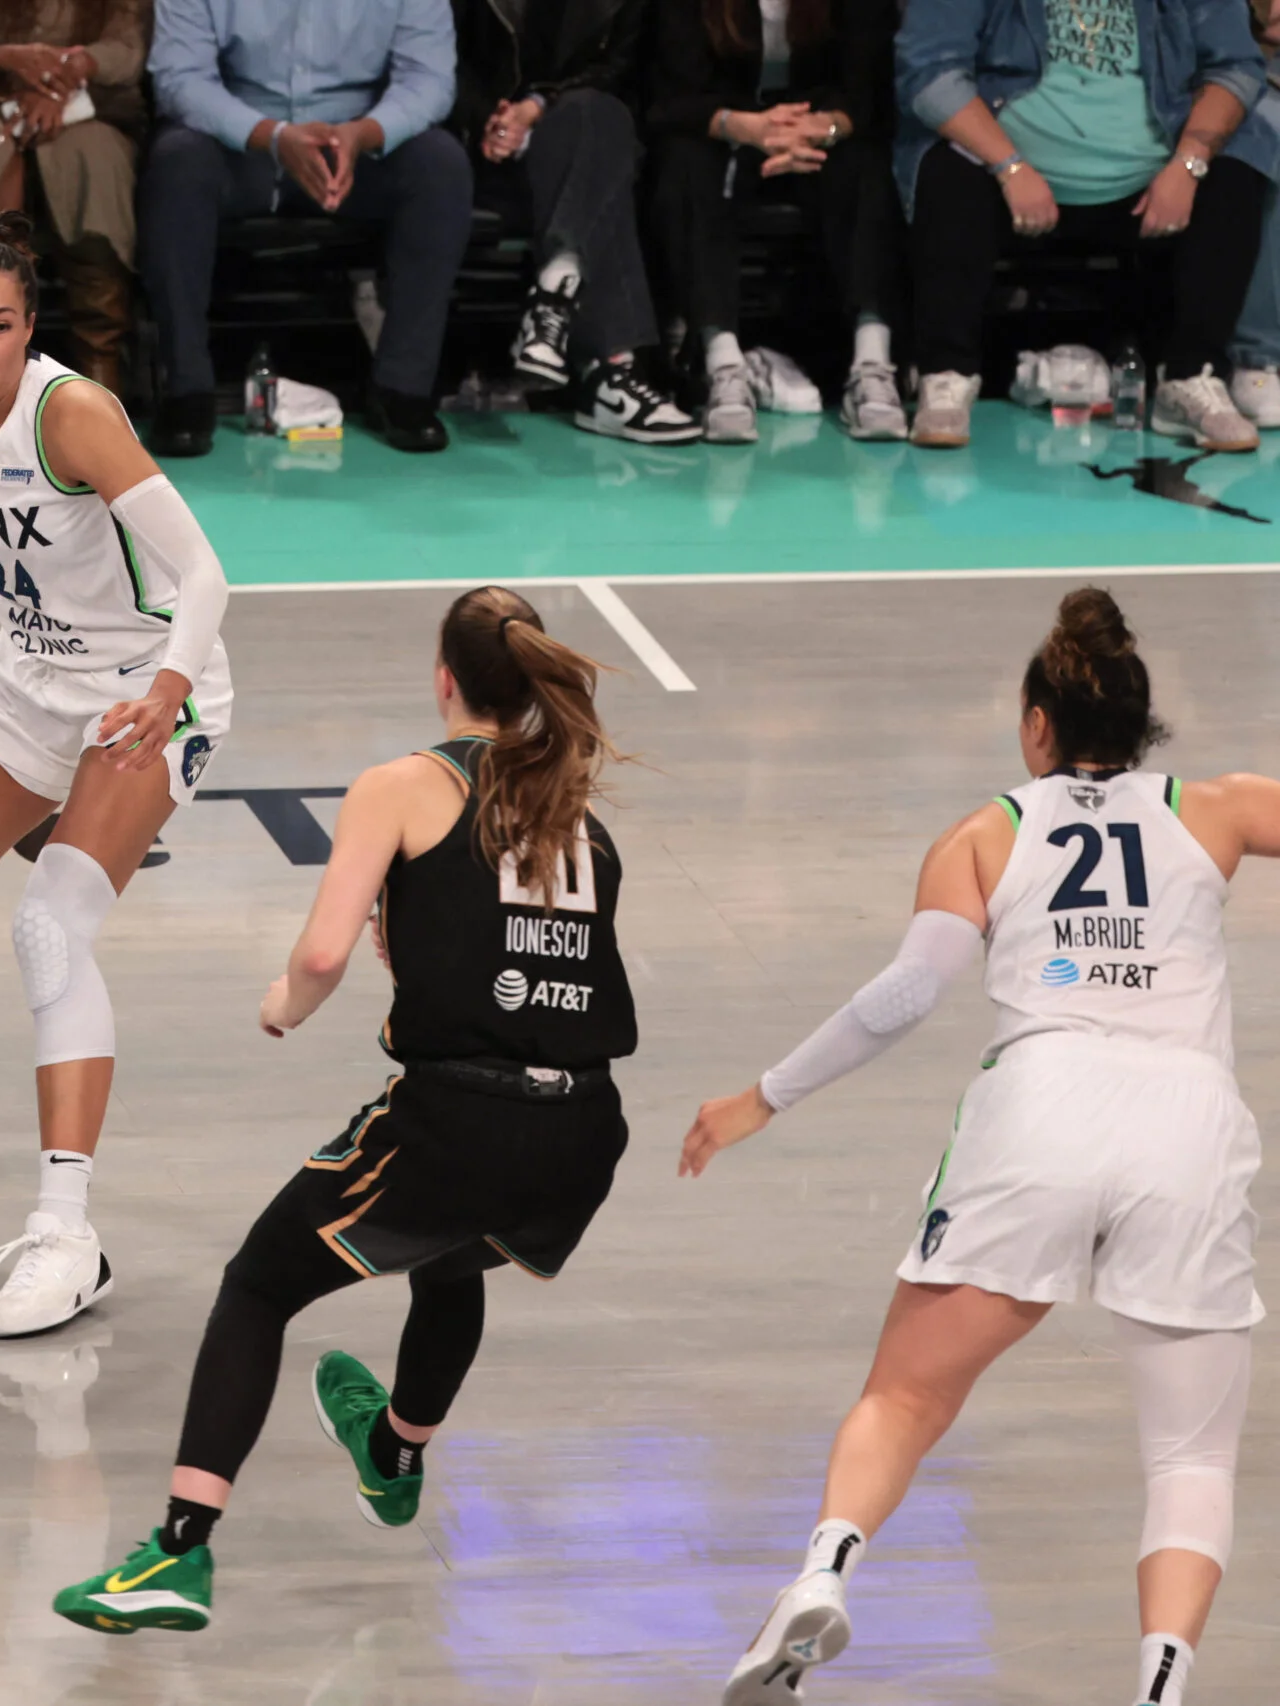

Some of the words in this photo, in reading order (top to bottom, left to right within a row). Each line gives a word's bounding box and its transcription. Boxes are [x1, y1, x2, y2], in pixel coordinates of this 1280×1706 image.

[10, 630, 89, 655] CLINIC
[1046, 822, 1150, 913] 21
[505, 915, 591, 961] IONESCU
[1053, 916, 1146, 950] McBRIDE
[1086, 963, 1159, 990] AT&T
[530, 980, 594, 1012] AT&T
